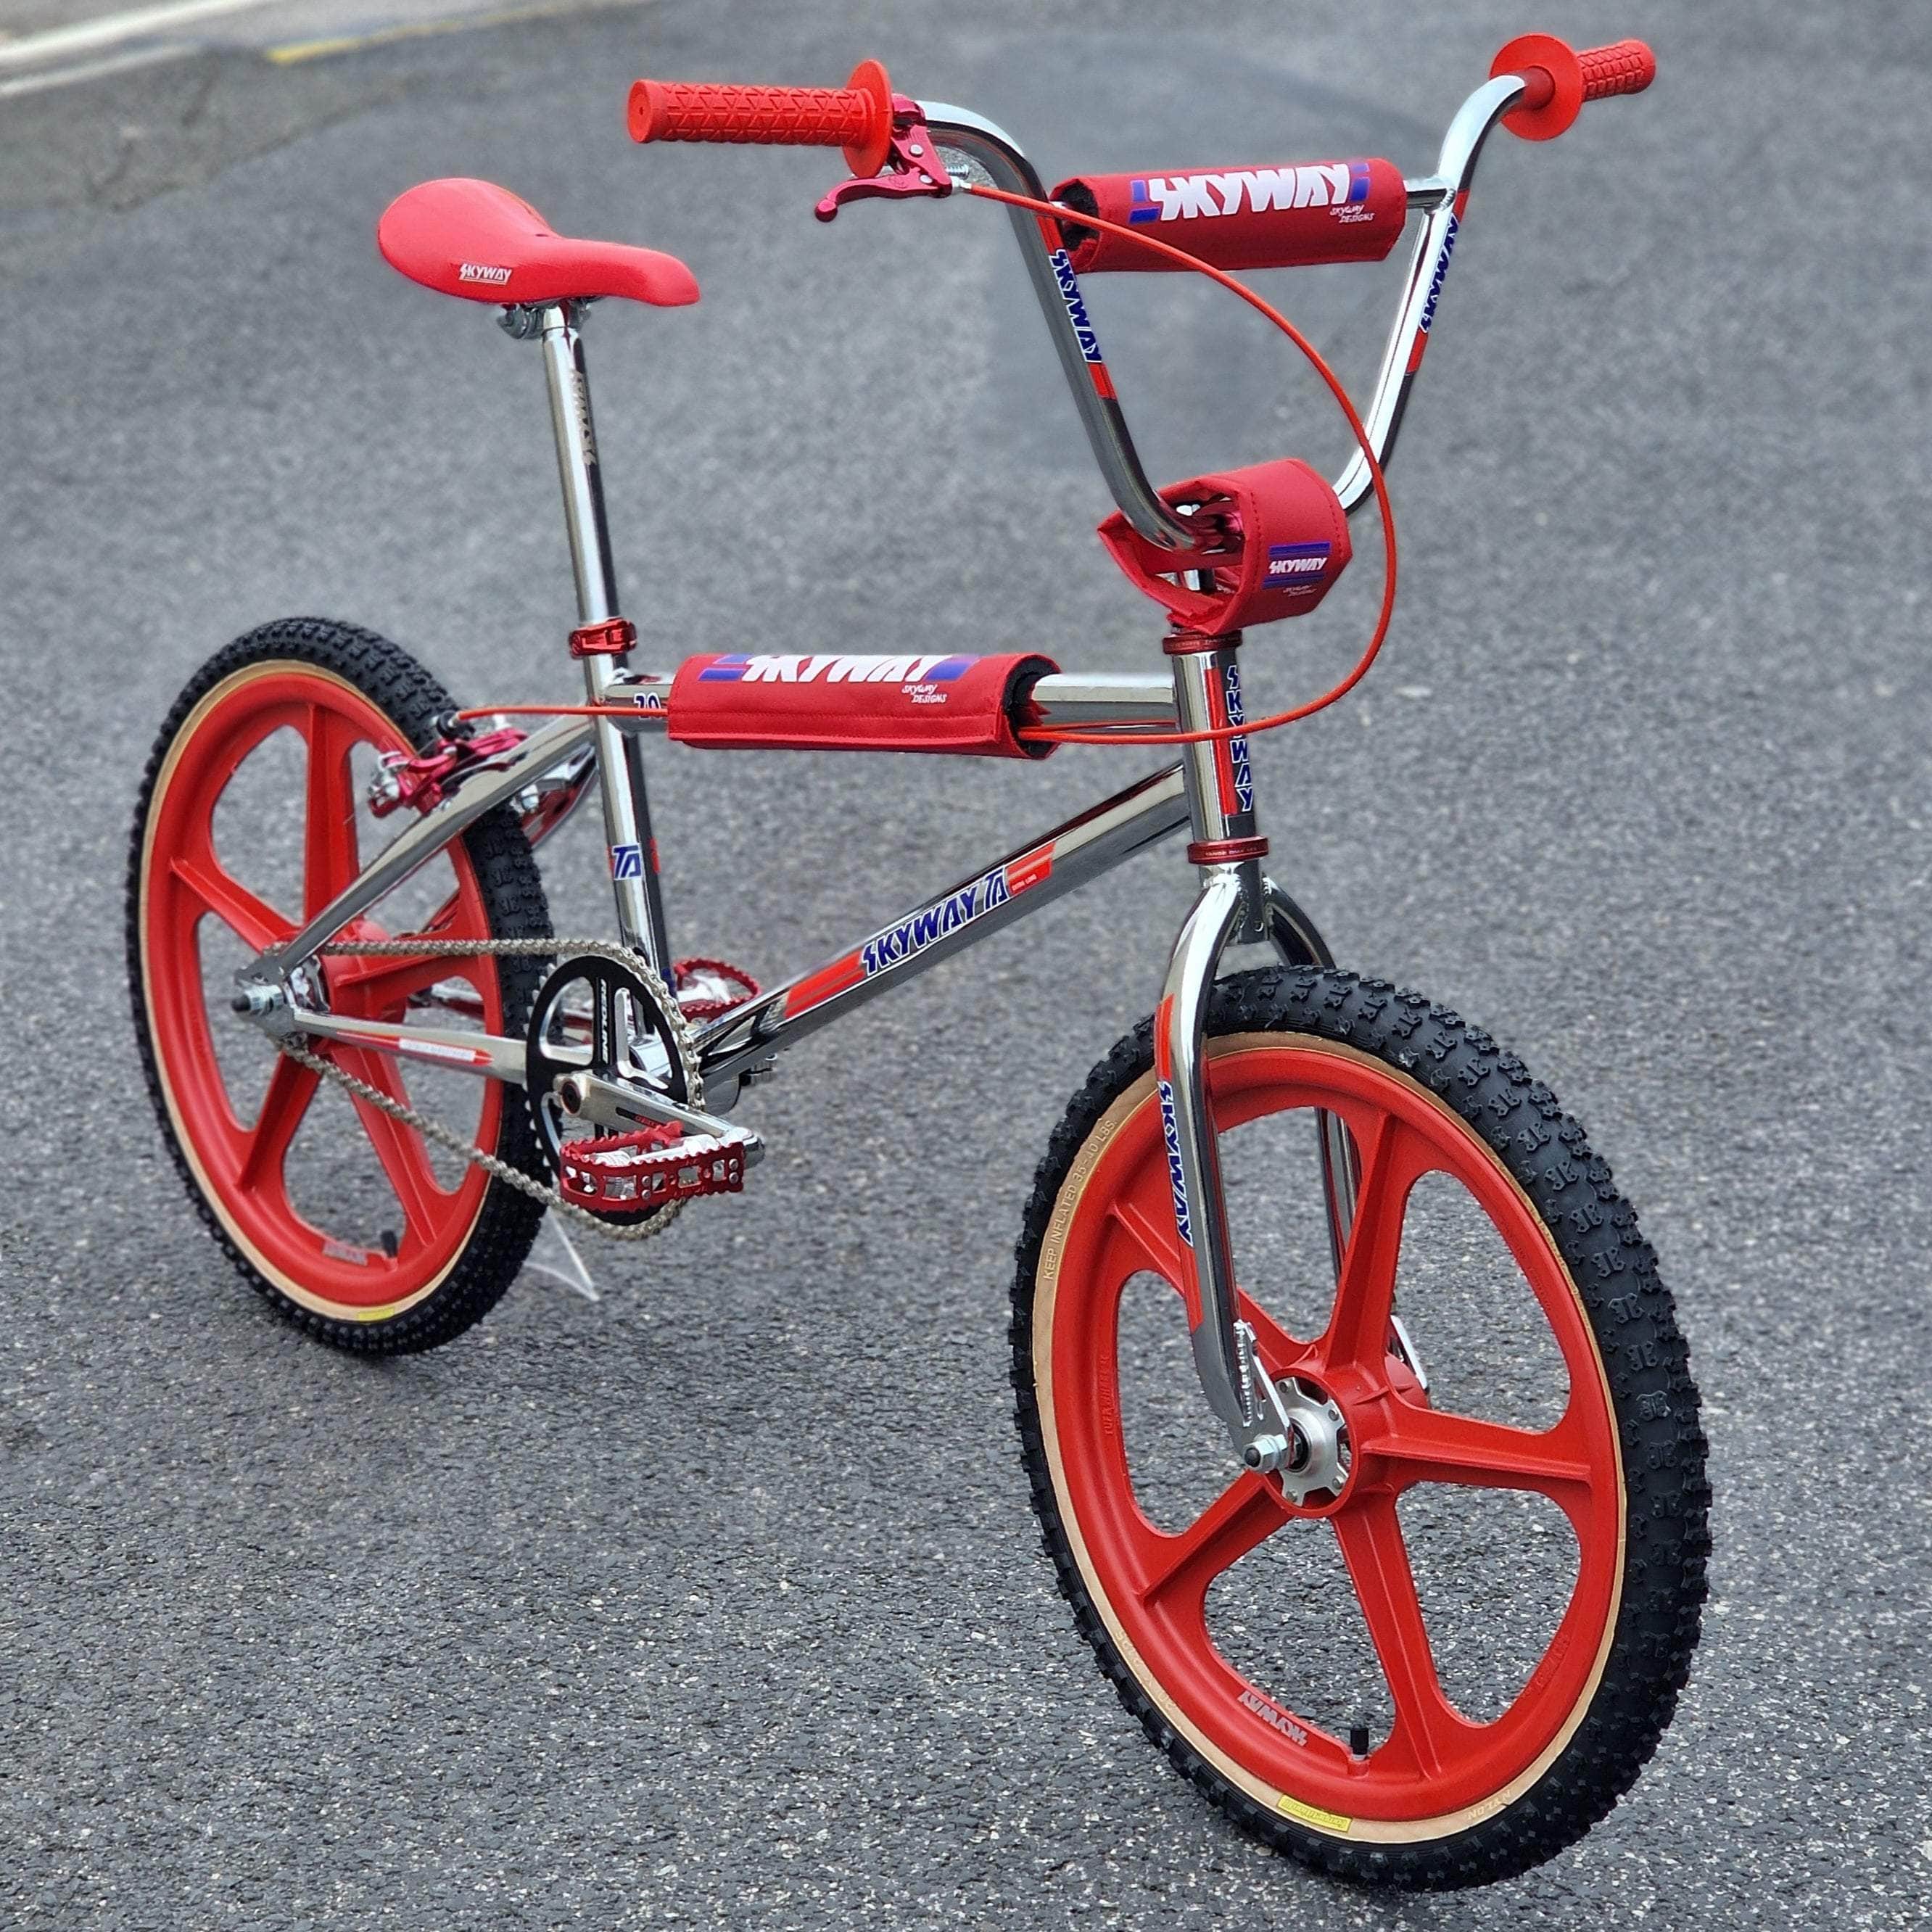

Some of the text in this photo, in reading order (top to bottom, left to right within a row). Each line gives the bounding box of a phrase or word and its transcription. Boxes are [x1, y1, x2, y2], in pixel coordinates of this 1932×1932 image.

[1148, 163, 1350, 220] SKYWAY
[1339, 212, 1374, 223] DESIGNS
[459, 263, 511, 284] SKYWAY
[1049, 248, 1102, 363] SKYWAY
[1269, 558, 1328, 574] SKYWAY
[911, 693, 947, 704] DESIGNS
[861, 885, 979, 977] SKYWAY
[1157, 1081, 1194, 1248] SKYWAY
[1043, 1249, 1057, 1281] KEEP
[1051, 1184, 1077, 1244] INFLATED
[1237, 1690, 1308, 1747] SKYWAY
